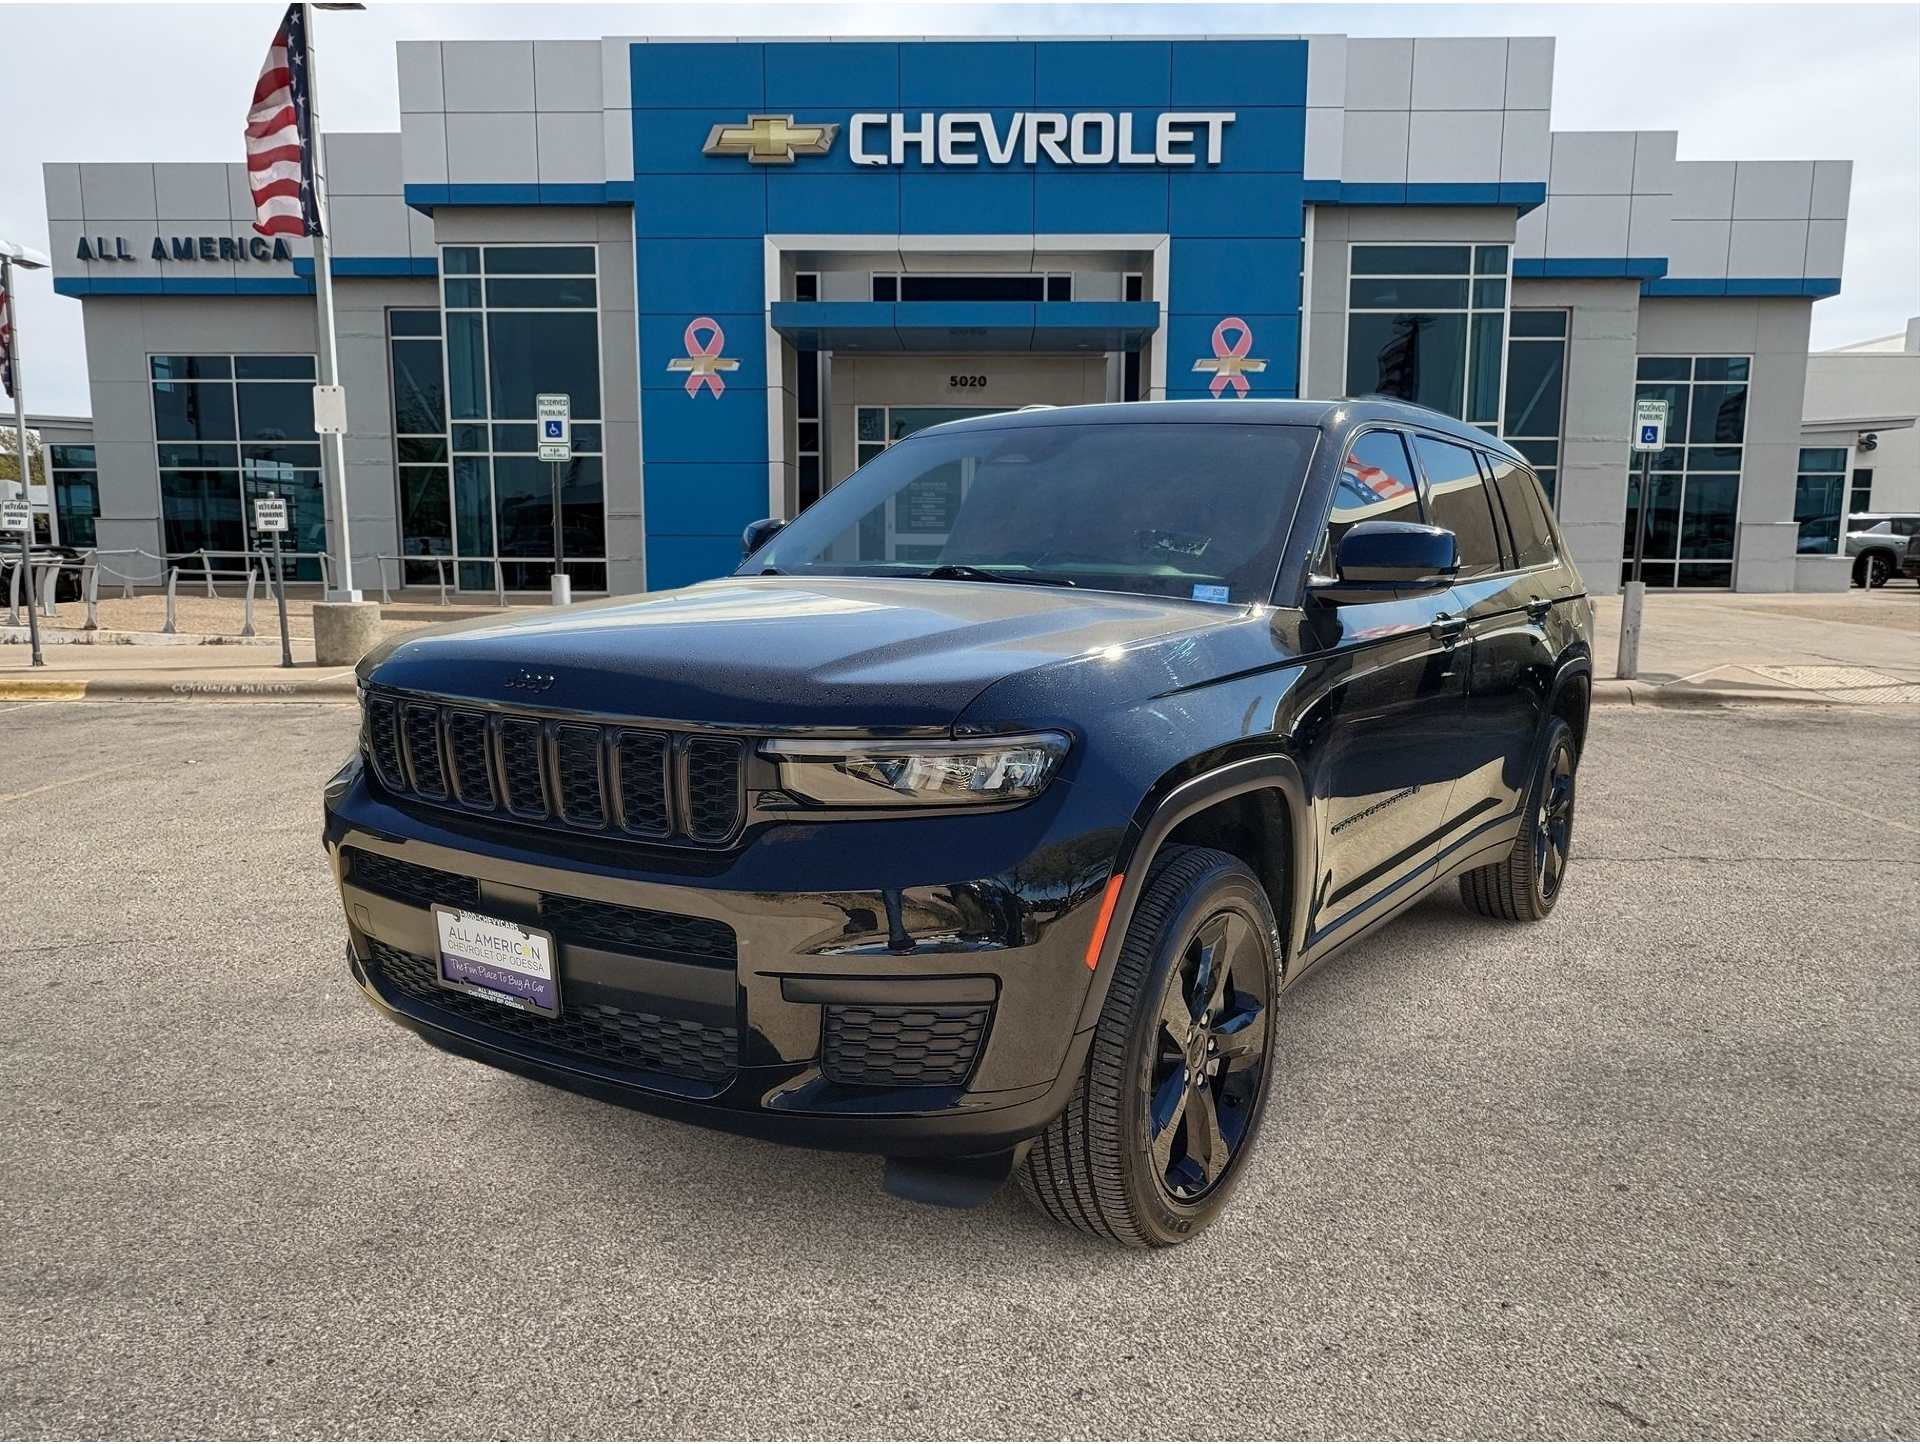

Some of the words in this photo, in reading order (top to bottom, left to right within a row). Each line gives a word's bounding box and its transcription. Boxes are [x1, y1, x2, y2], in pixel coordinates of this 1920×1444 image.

[849, 112, 1236, 165] CHEVROLET
[76, 237, 134, 261] ALL
[151, 237, 291, 261] AMERICA
[950, 375, 987, 387] 5020
[541, 409, 566, 417] PARKING
[449, 926, 471, 943] ALL
[447, 940, 493, 960] CHEVROLET
[496, 952, 507, 963] OF
[510, 956, 545, 973] ODESSA
[450, 958, 465, 971] The
[463, 962, 479, 976] Fun
[479, 966, 498, 981] Place
[497, 971, 507, 984] To
[508, 974, 523, 991] Buy
[523, 980, 531, 990] A
[531, 981, 545, 993] Car
